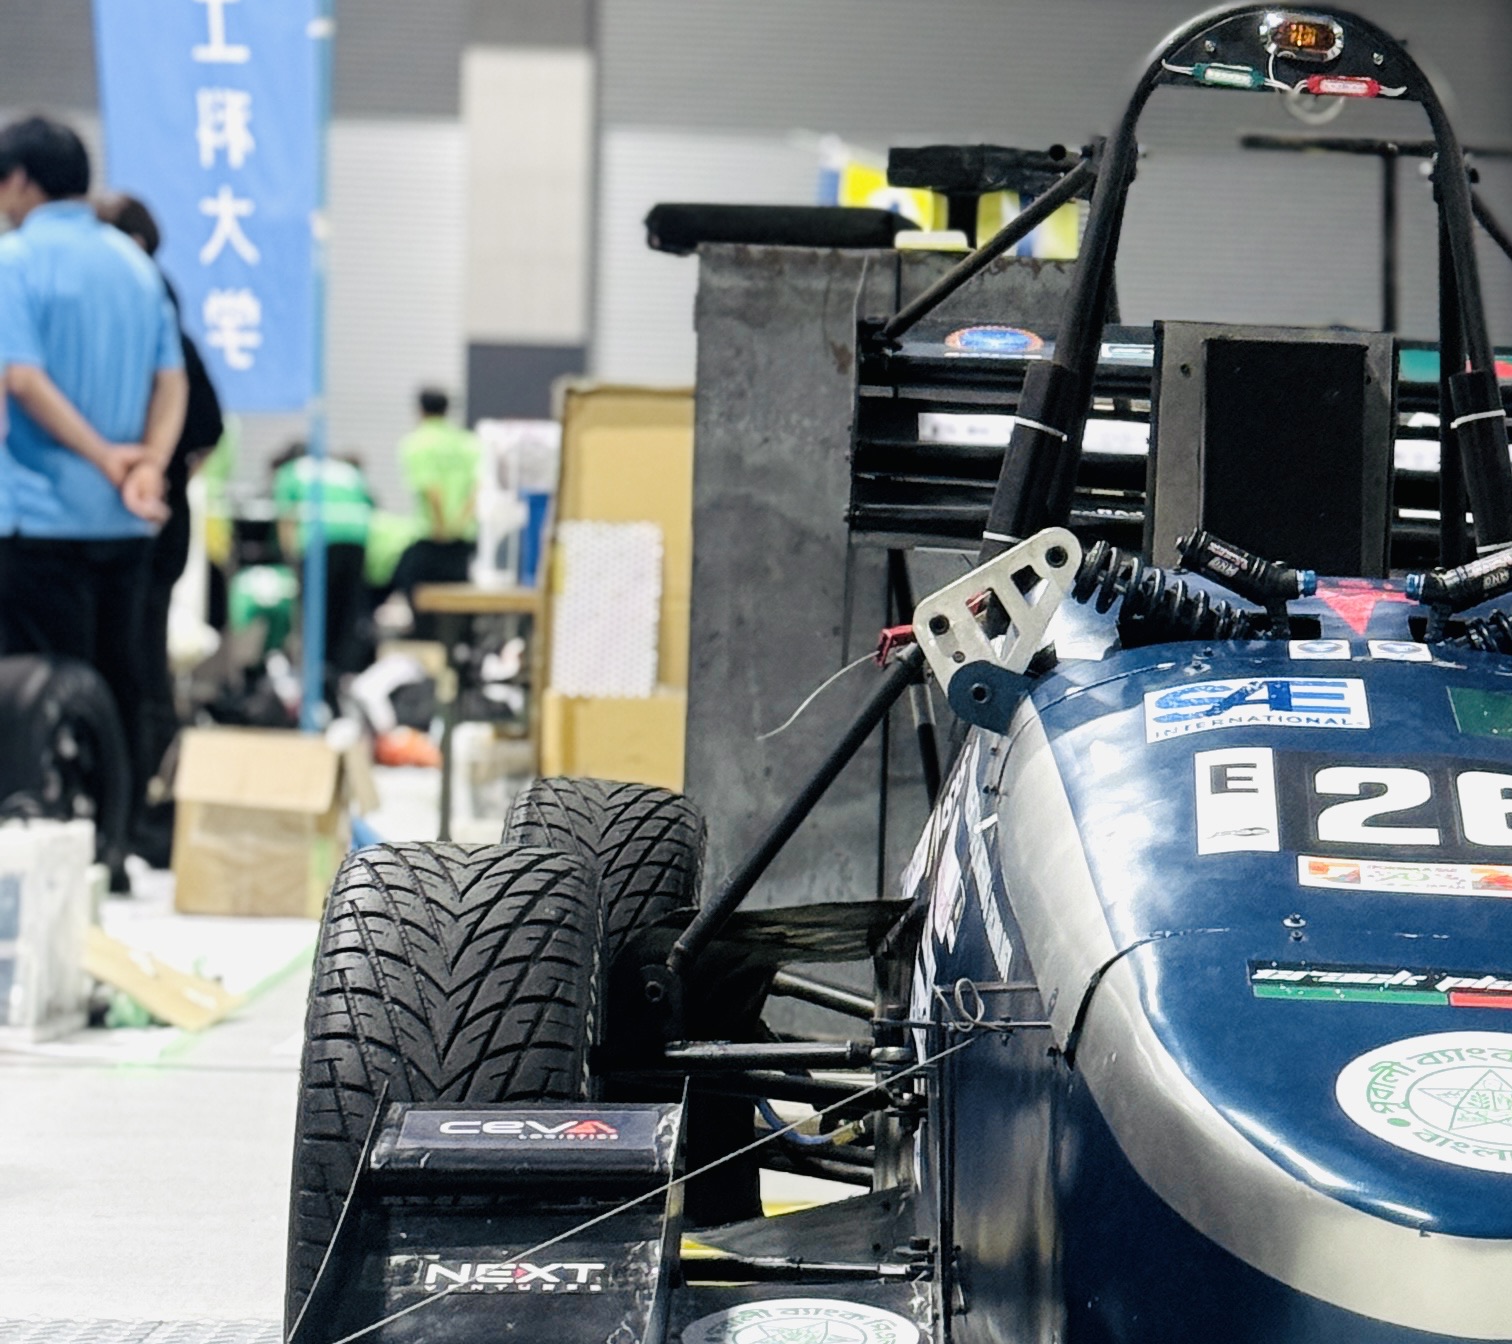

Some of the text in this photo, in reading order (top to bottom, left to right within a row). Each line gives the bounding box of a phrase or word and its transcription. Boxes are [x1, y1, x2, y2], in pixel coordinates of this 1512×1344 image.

[1152, 679, 1351, 724] SAE
[1154, 714, 1356, 739] INTERNATIONAL
[1209, 762, 1259, 795] E
[424, 1262, 606, 1284] NEXT
